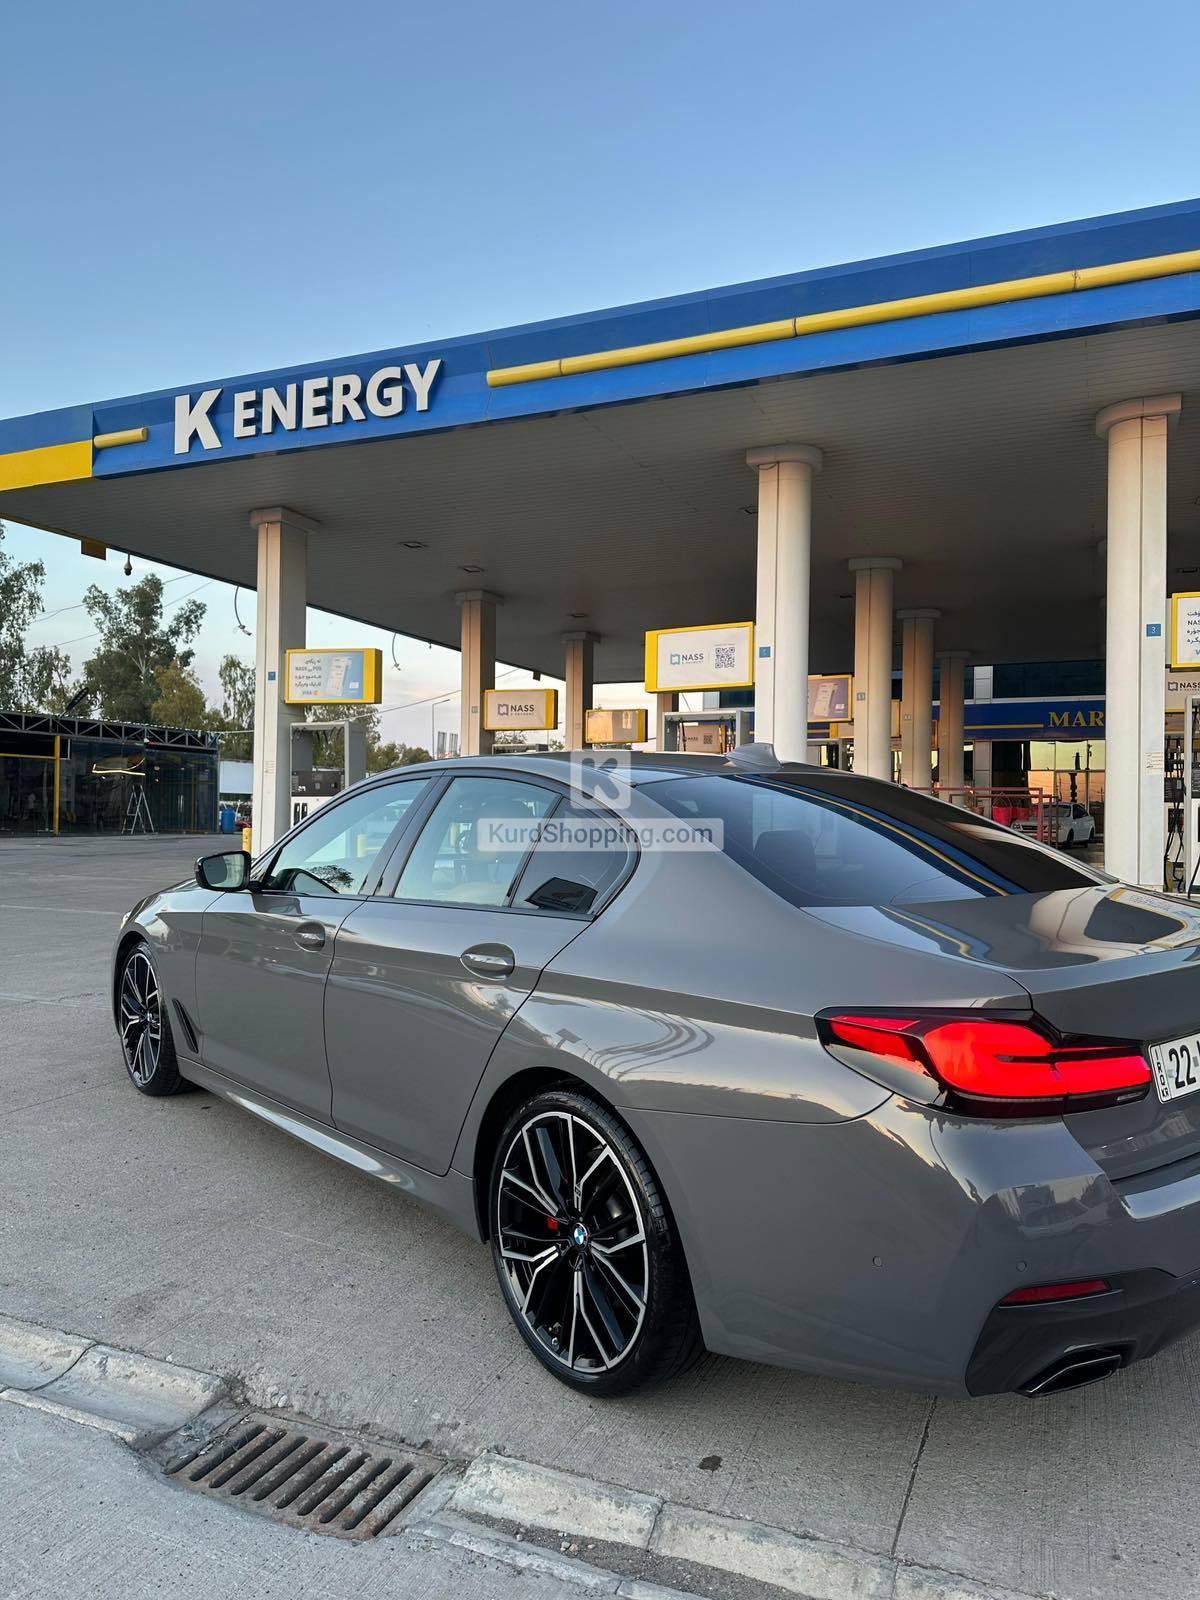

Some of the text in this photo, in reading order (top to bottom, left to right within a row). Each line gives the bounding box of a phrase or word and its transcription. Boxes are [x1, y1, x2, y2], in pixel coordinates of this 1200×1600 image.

[174, 359, 442, 455] K ENERGY
[681, 653, 704, 662] NASS
[510, 704, 535, 712] NASS
[1168, 1045, 1197, 1089] 22
